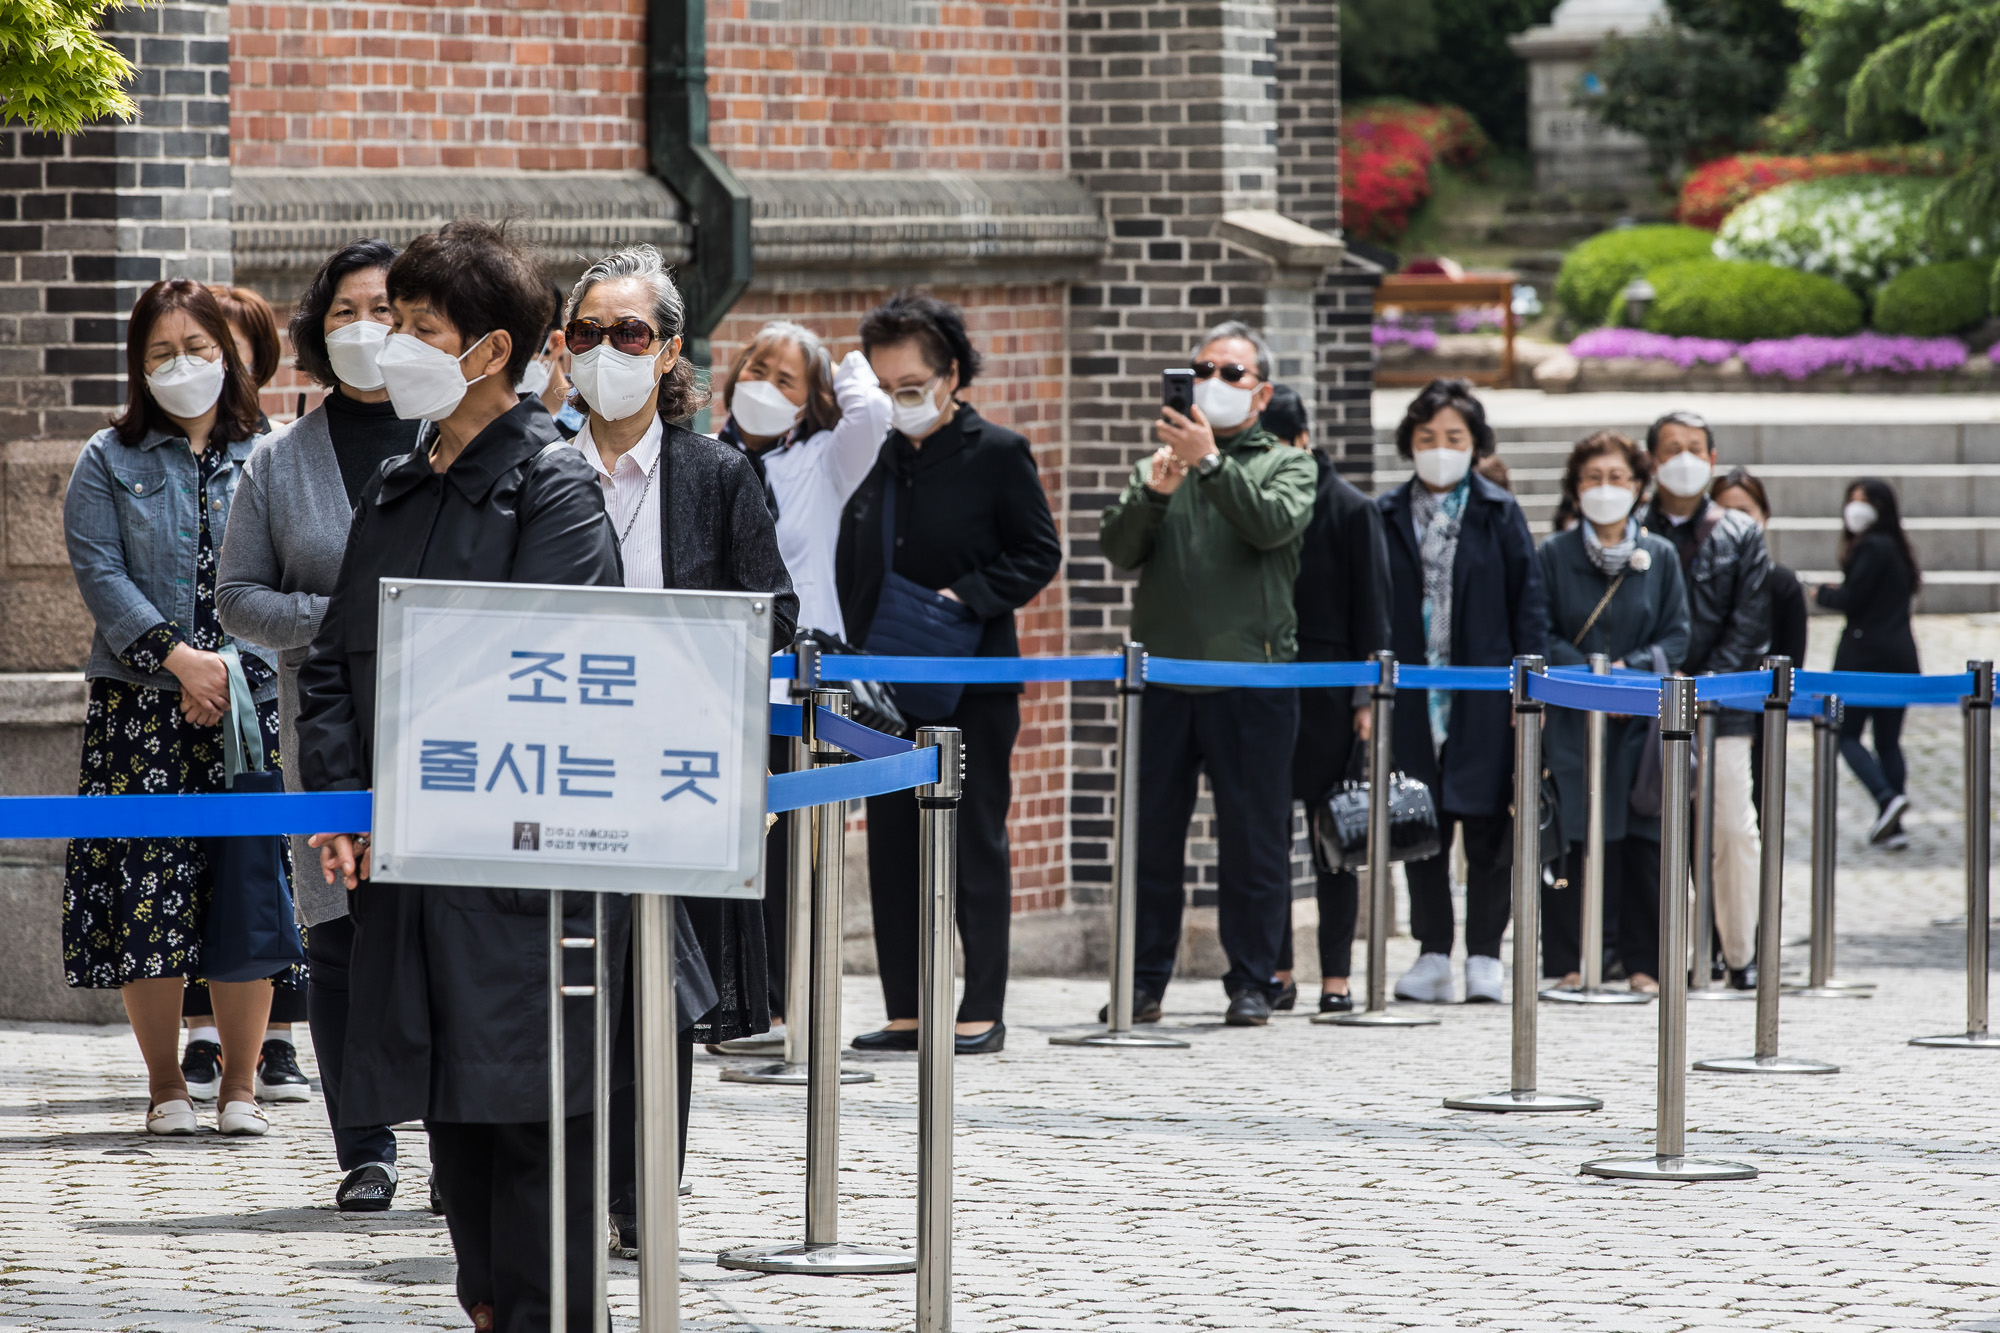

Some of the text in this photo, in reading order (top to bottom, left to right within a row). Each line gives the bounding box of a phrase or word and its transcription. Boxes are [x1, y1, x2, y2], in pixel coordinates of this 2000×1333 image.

[507, 650, 637, 707] 조문
[419, 738, 721, 805] 줄서는 곳
